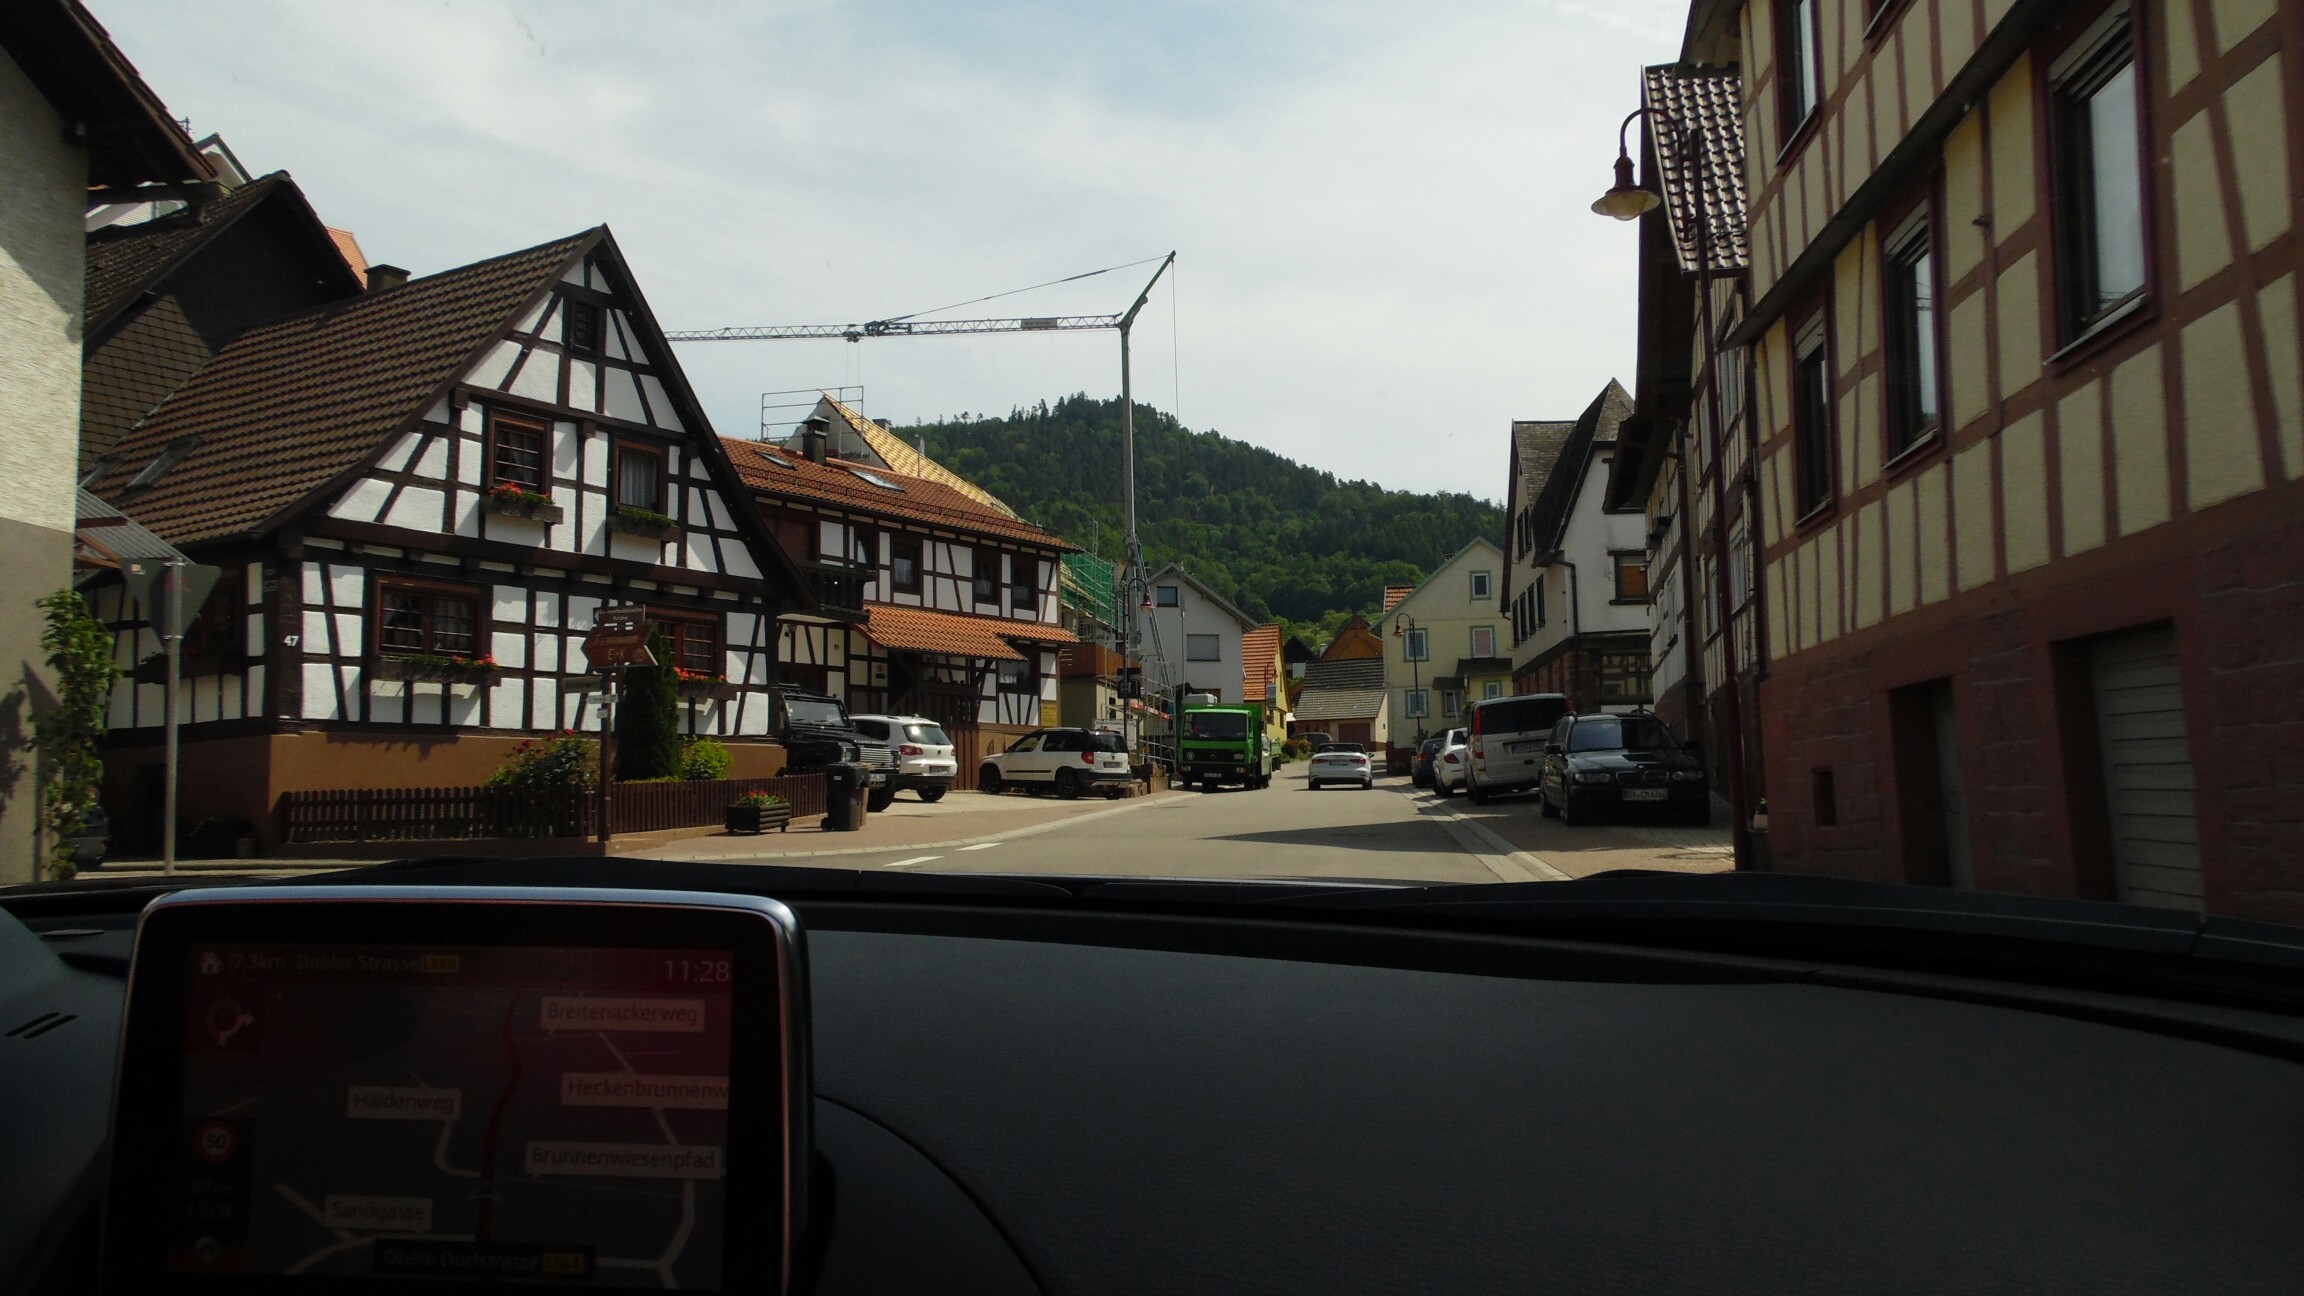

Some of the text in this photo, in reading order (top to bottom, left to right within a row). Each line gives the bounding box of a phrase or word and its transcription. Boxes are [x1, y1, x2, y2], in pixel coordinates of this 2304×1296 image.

[283, 635, 300, 647] 47
[296, 953, 353, 970] Dobler
[359, 954, 420, 971] Strasse
[665, 960, 731, 983] 11:28
[547, 1002, 698, 1026] Breitenackerweg
[354, 1092, 455, 1115] Haldenweg
[206, 1133, 226, 1149] 50
[532, 1147, 715, 1172] Brunnenwiesenpfad
[332, 1200, 425, 1224] Sandgasse
[384, 1248, 437, 1267] Obere
[439, 1249, 539, 1271] Dorfstrasse
